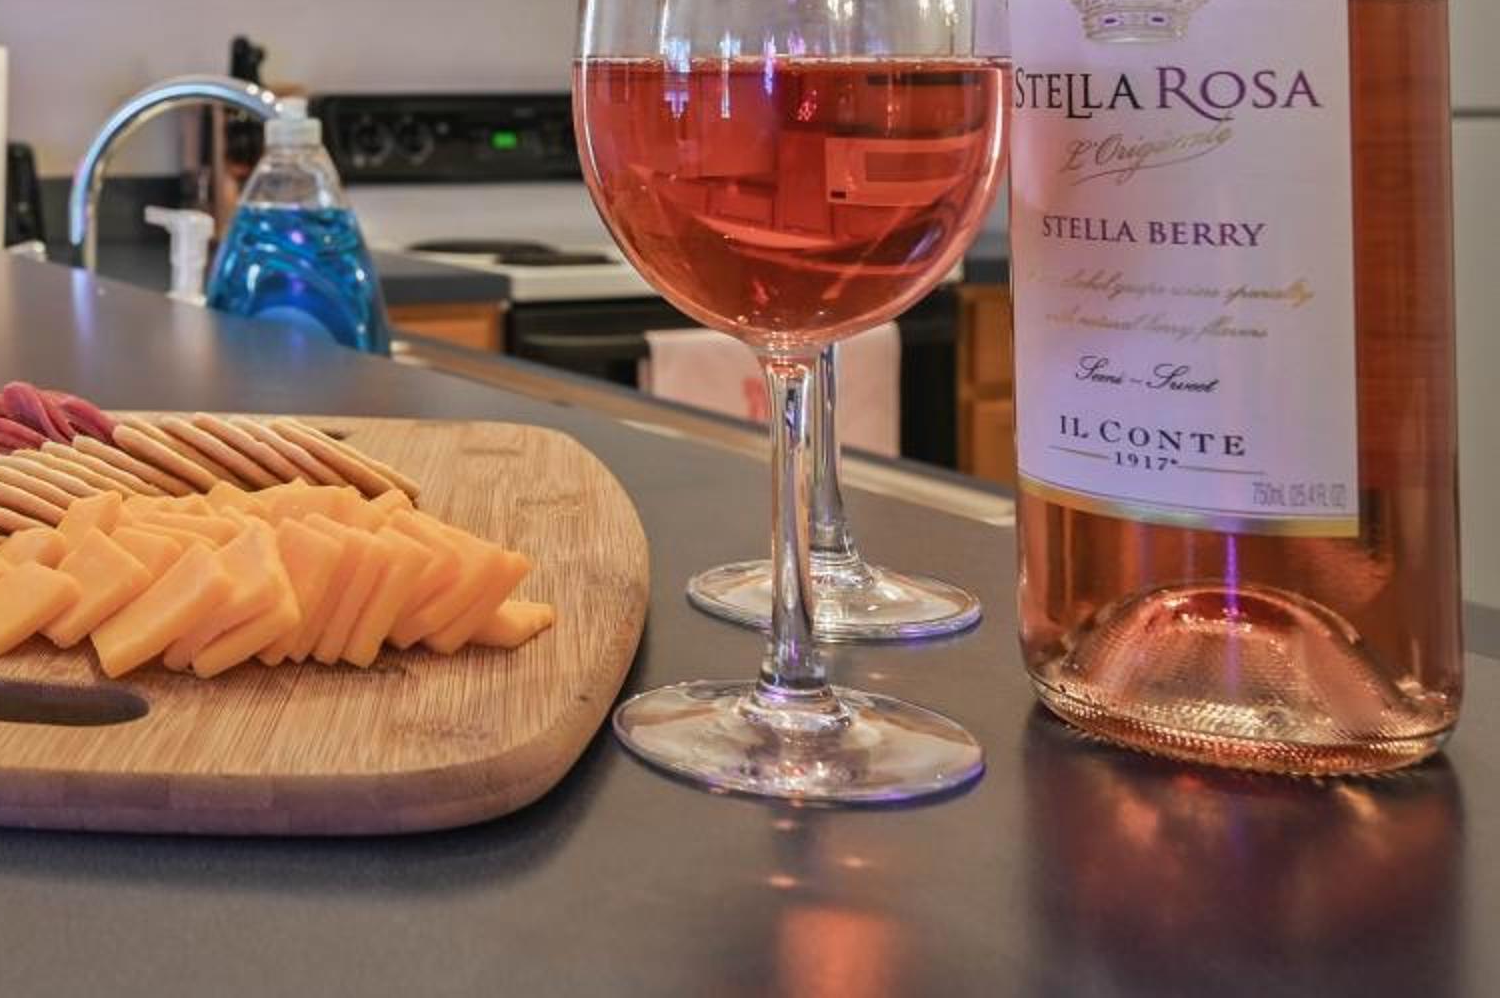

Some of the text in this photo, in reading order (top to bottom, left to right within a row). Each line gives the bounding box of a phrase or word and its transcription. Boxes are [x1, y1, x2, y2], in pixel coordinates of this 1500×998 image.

[1015, 66, 1324, 121] STELLA ROSA
[1041, 215, 1267, 247] STELLA BERRY
[1059, 414, 1247, 458] IL CONTE
